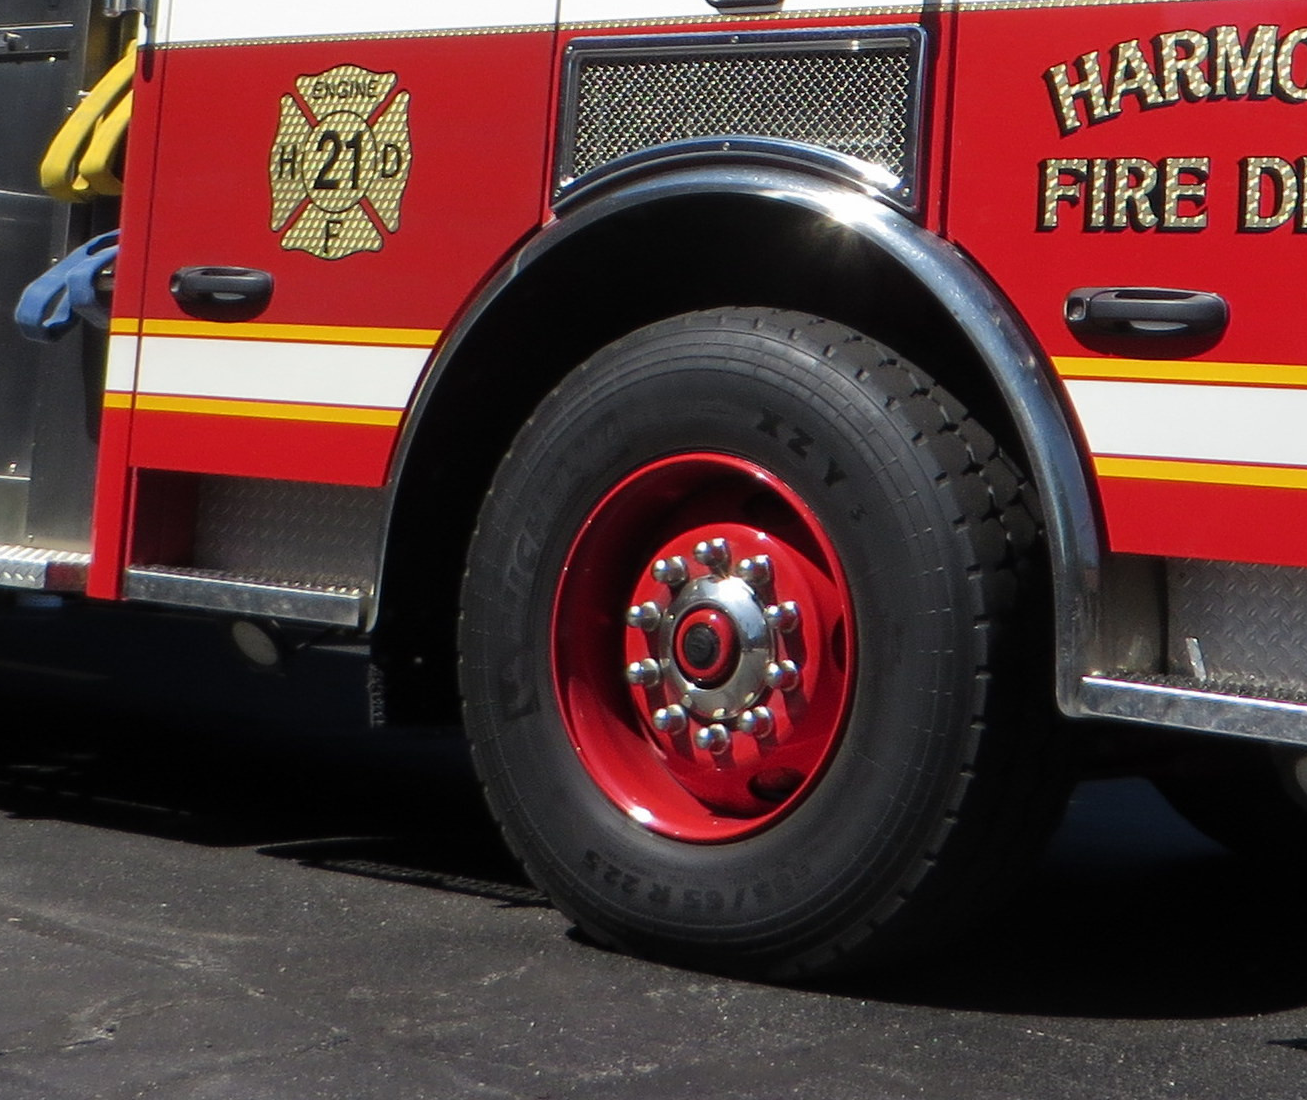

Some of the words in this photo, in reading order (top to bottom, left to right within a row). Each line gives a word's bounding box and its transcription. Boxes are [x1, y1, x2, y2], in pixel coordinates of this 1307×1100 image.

[312, 79, 379, 100] ENGINE
[277, 144, 298, 180] H
[312, 129, 366, 191] 21
[380, 143, 403, 179] D
[1035, 155, 1211, 234] FIRE
[322, 219, 343, 254] F
